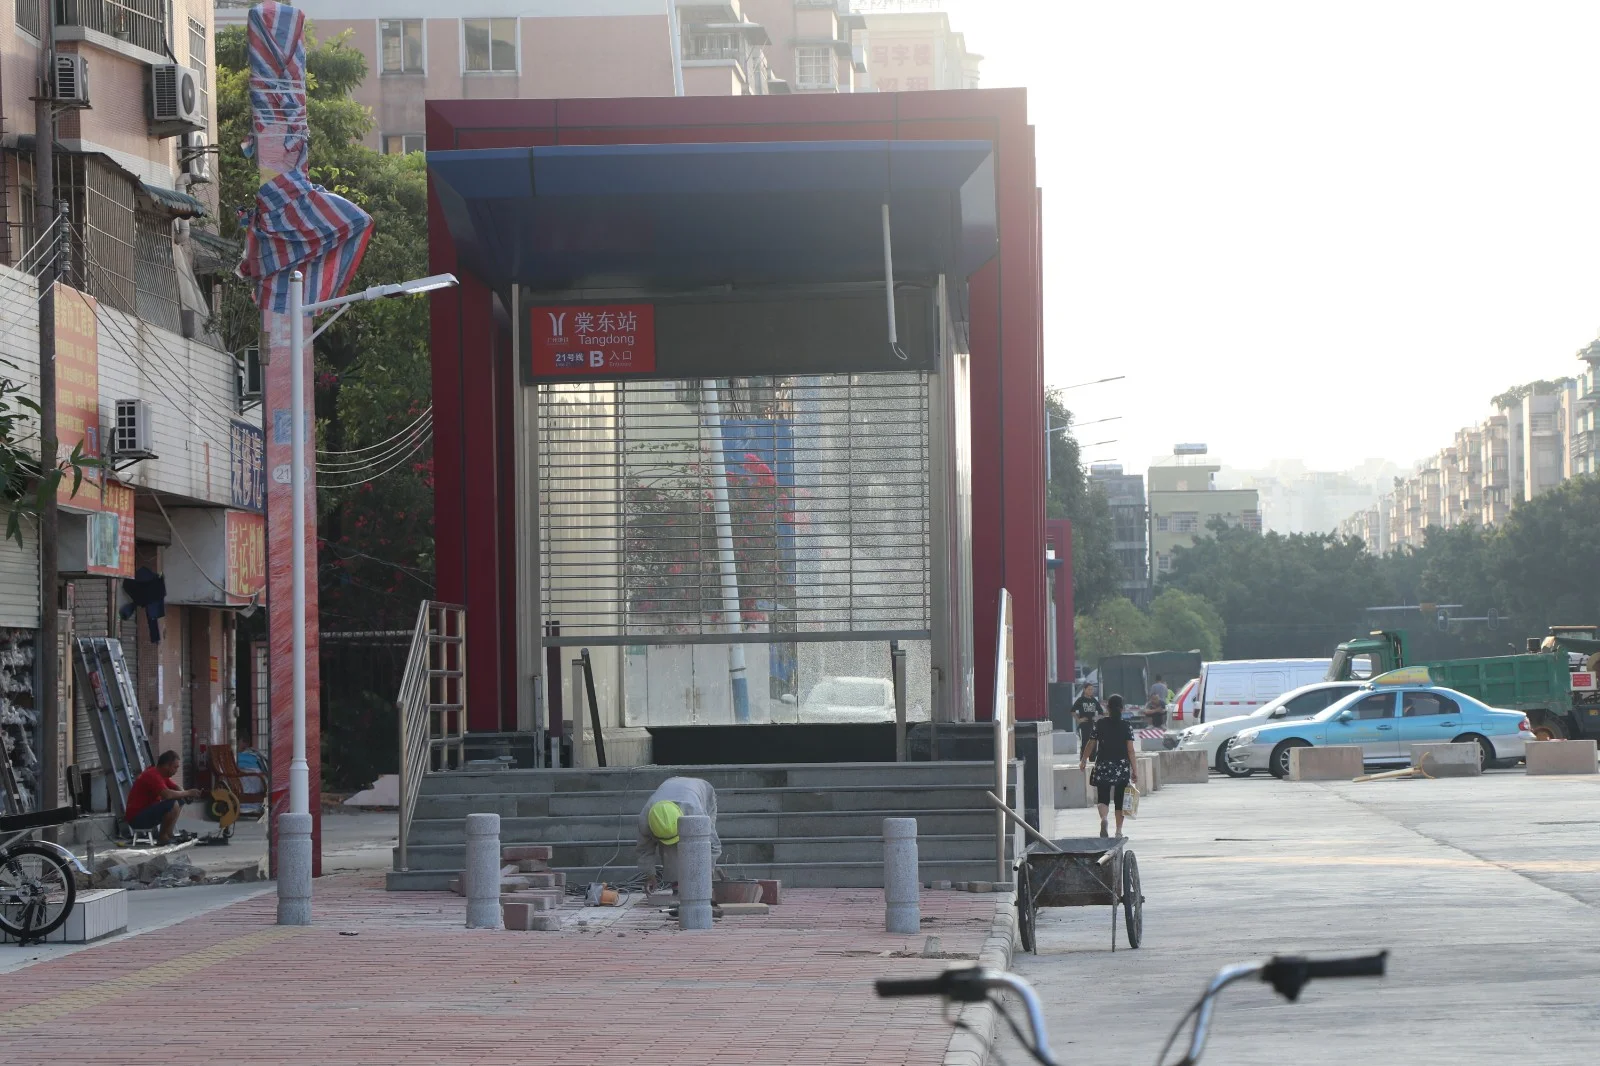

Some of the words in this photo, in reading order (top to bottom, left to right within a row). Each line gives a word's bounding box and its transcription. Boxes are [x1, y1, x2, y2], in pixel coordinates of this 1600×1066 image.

[574, 311, 637, 334] 棠东站
[578, 334, 635, 347] Tangdong
[555, 353, 584, 362] 21号线
[589, 350, 605, 368] B
[609, 350, 632, 361] 入口
